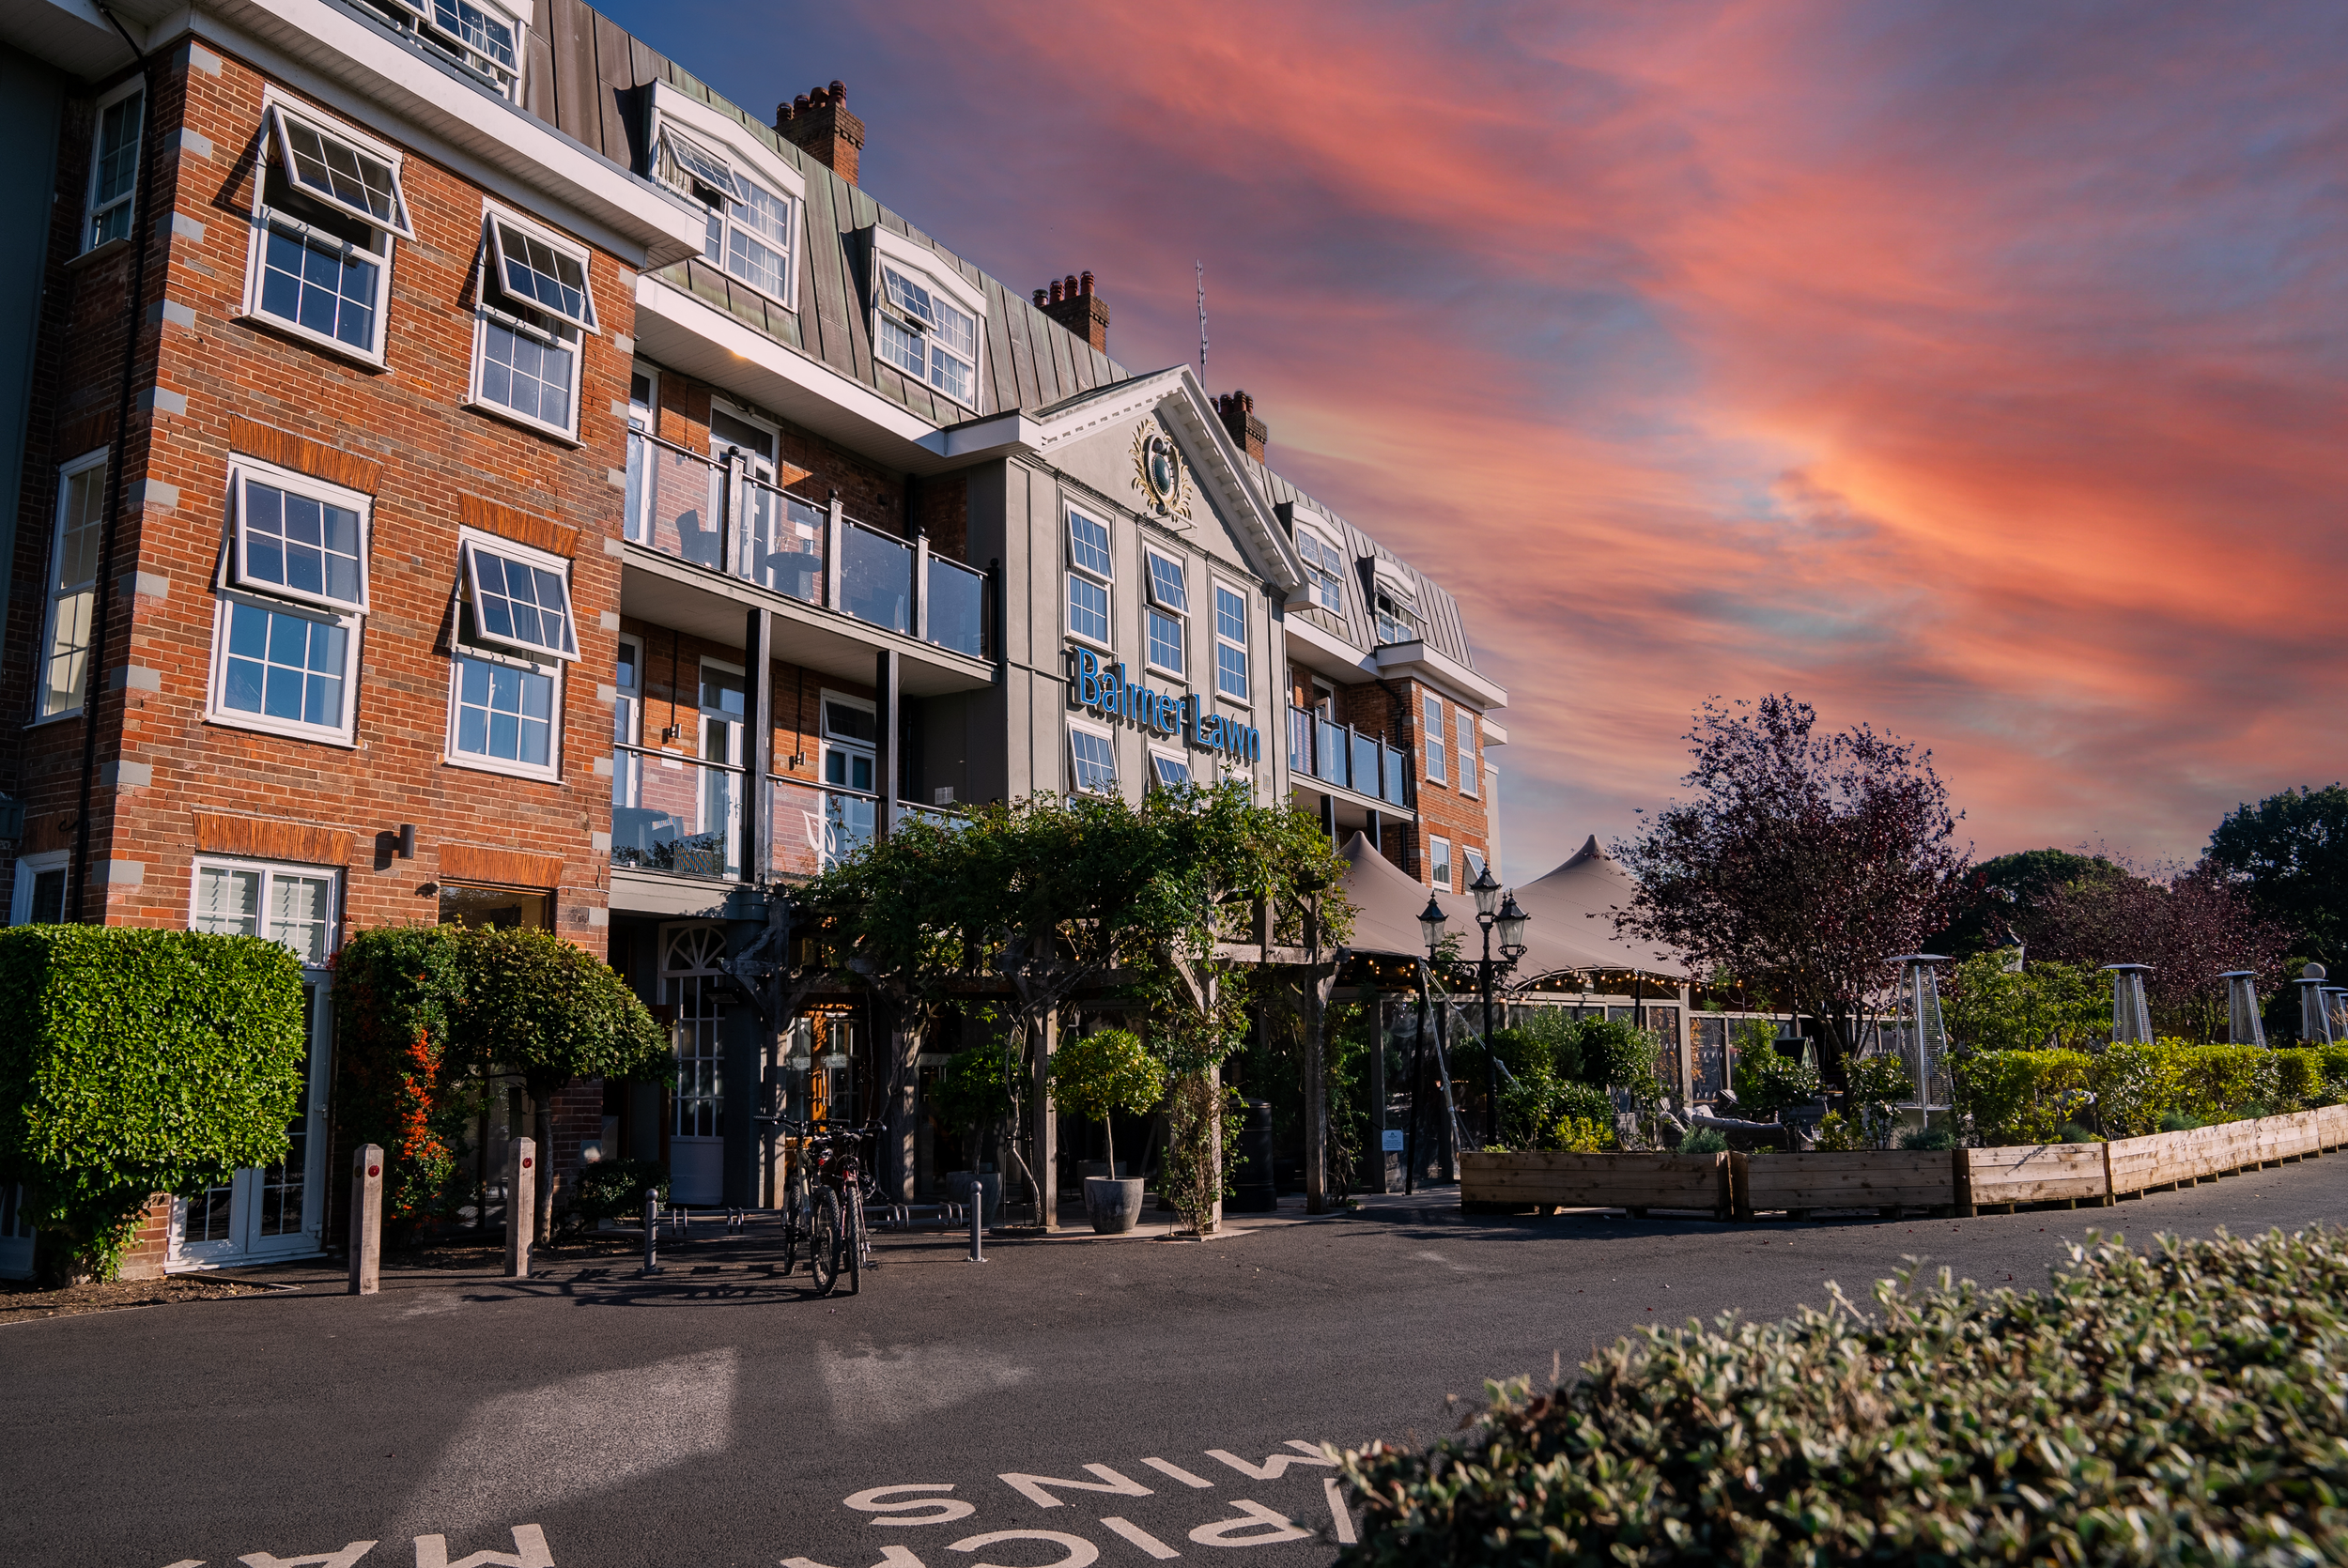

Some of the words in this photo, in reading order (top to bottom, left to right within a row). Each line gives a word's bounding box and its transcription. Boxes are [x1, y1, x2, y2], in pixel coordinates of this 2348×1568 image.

[1074, 645, 1185, 735] Balmer
[1193, 693, 1260, 762] Lawn
[843, 1439, 1343, 1526] MINS
